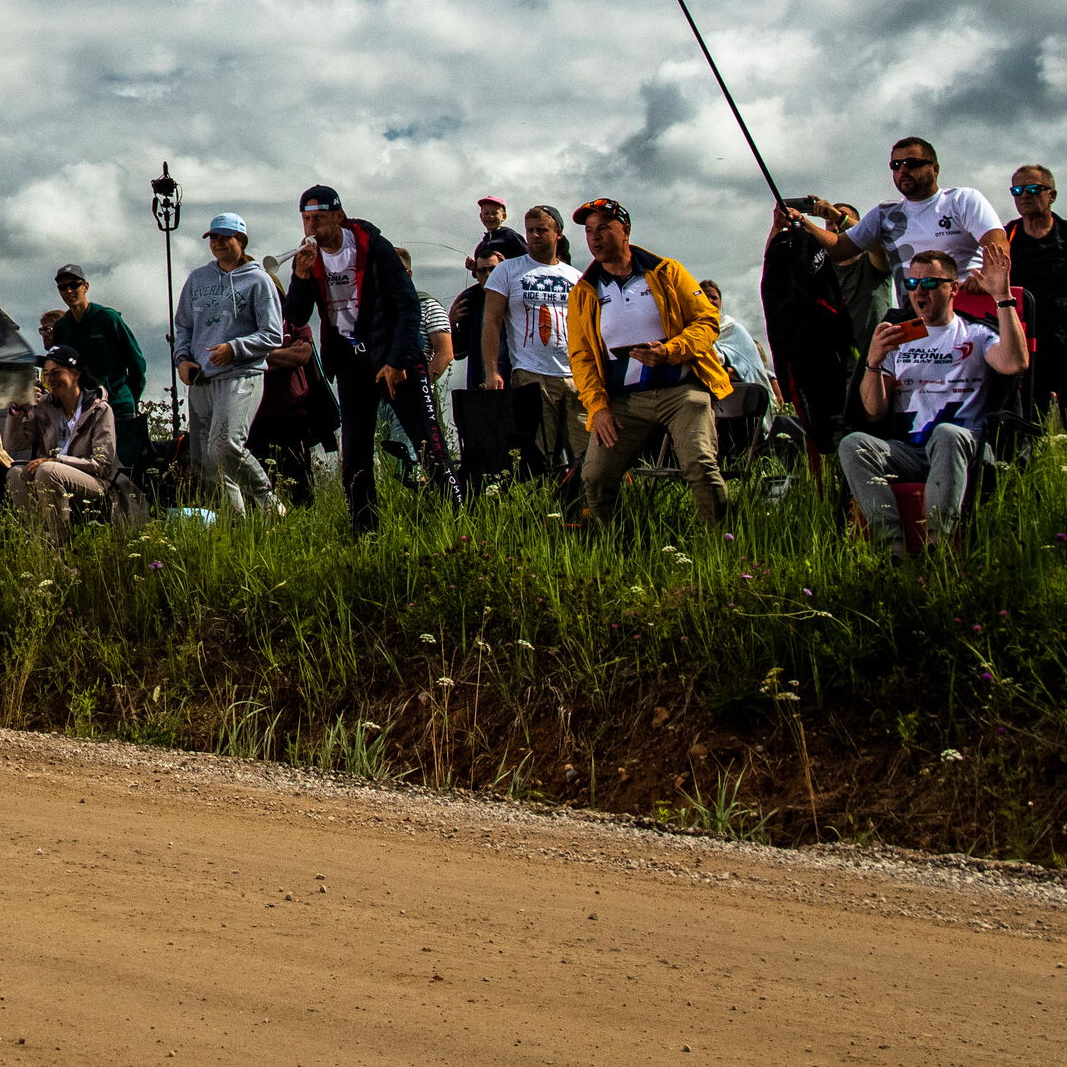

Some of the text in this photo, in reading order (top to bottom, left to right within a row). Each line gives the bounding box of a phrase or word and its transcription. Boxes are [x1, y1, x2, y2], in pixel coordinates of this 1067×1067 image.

[523, 292, 539, 300] RIDE
[543, 292, 556, 301] THE
[420, 377, 435, 421] TOMMY
